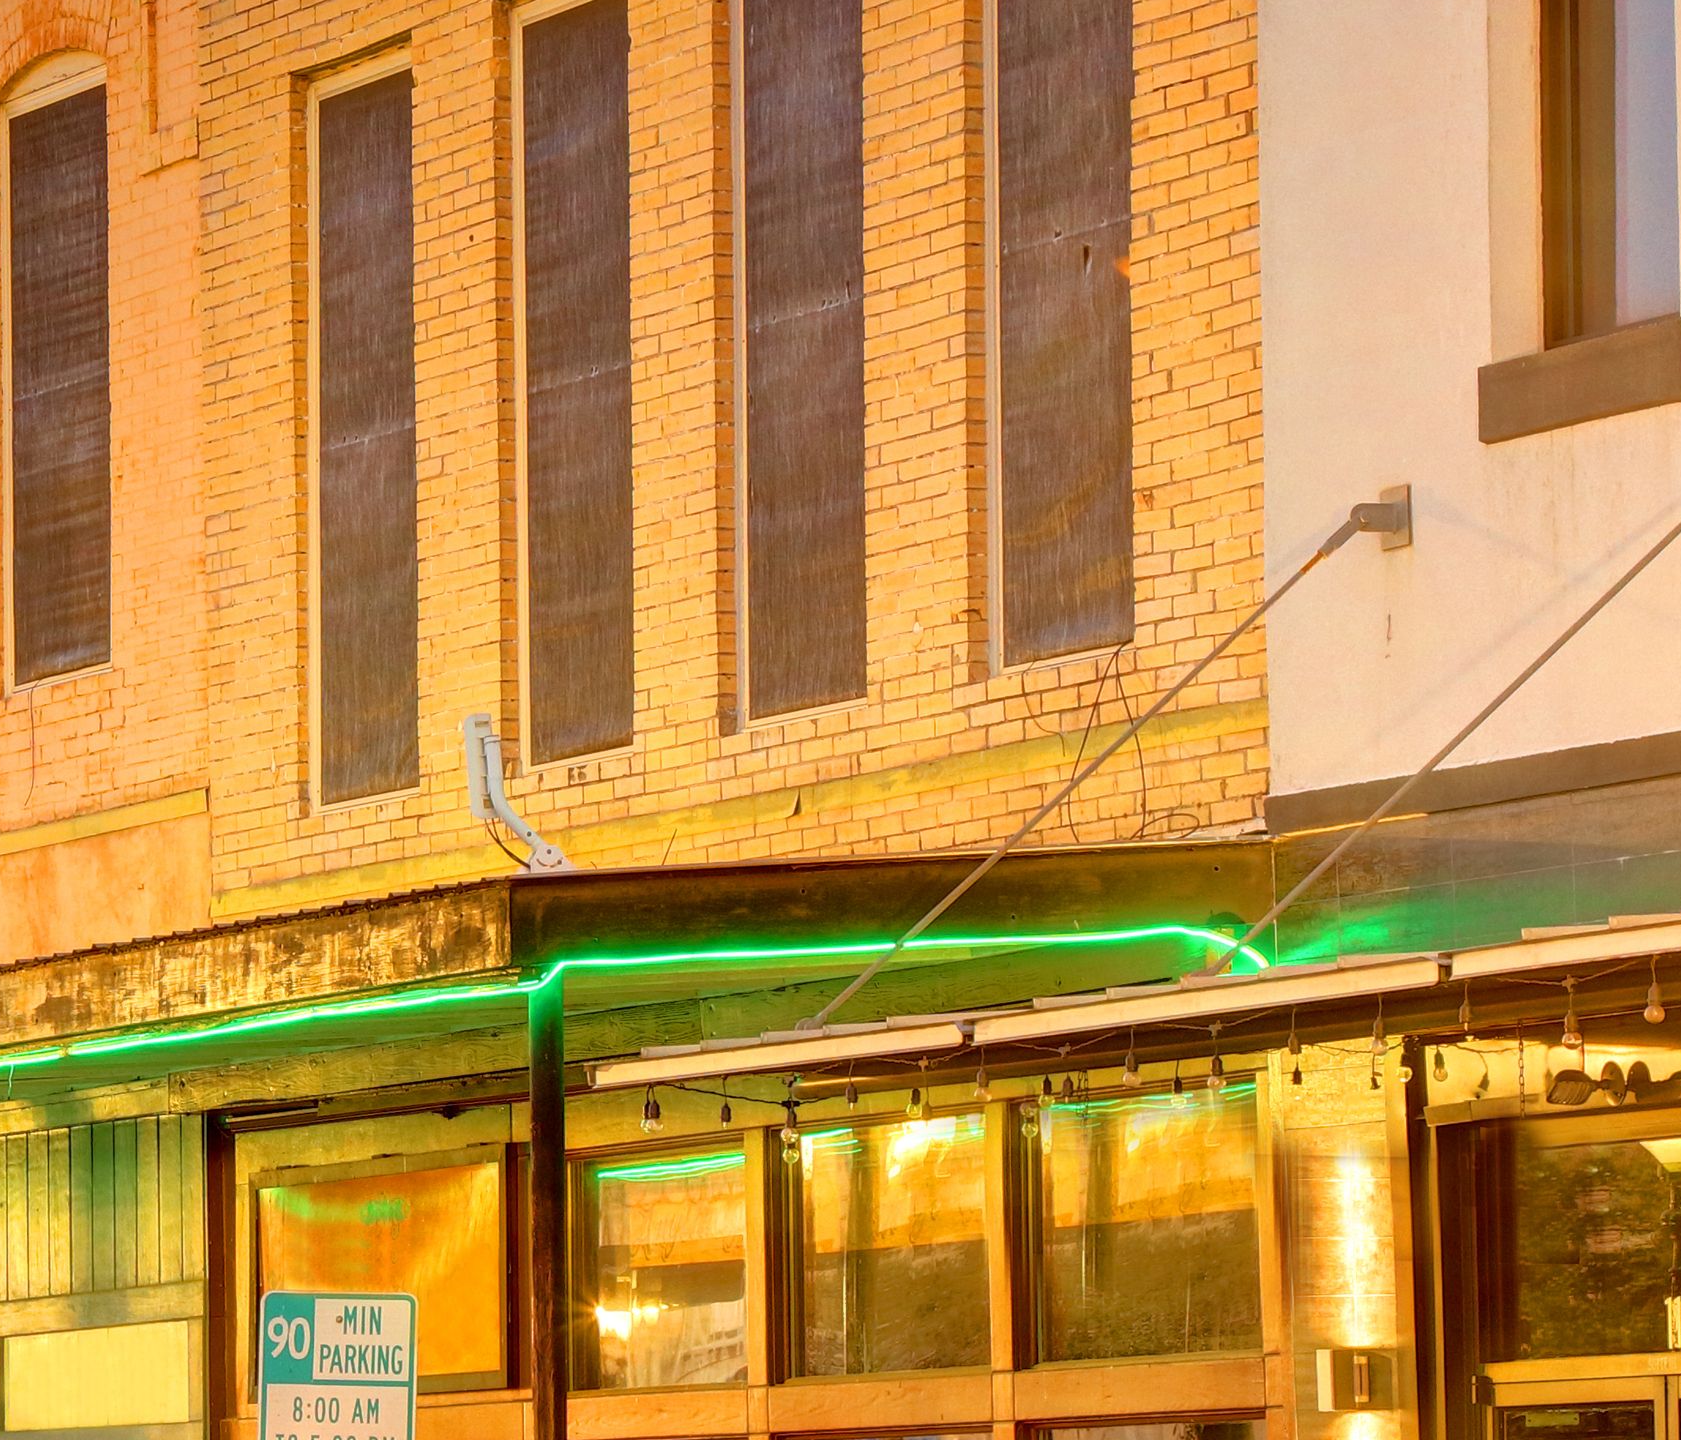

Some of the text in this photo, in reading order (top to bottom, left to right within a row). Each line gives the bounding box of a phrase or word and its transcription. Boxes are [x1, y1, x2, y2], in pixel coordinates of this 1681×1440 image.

[343, 1305, 382, 1335] MIN
[267, 1315, 311, 1360] 90
[319, 1344, 403, 1375] PARKING
[293, 1397, 379, 1424] 8:00 AM
